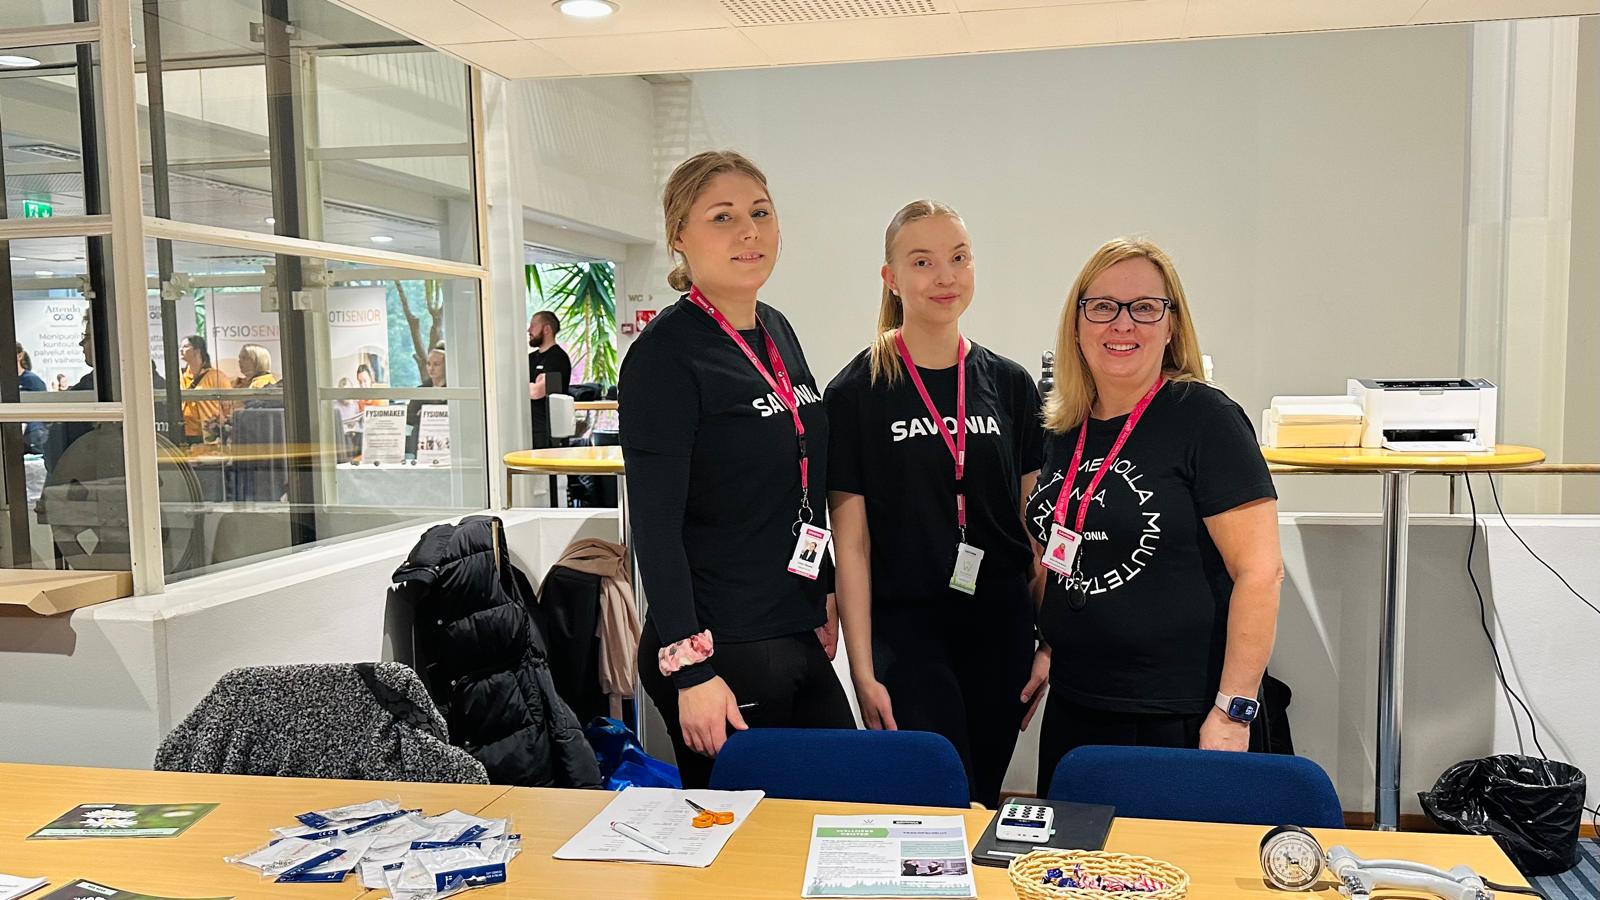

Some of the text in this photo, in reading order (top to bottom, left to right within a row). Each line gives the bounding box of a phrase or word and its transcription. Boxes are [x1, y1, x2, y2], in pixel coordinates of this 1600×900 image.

[45, 304, 80, 313] Attendo
[329, 309, 381, 323] OTISENIOR
[212, 324, 279, 338] FYSIOSENI
[365, 409, 405, 418] FYSIOMAKER
[423, 410, 449, 418] FYSIOMA
[891, 416, 1001, 441] SAVONIA
[1083, 531, 1108, 541] ONIA
